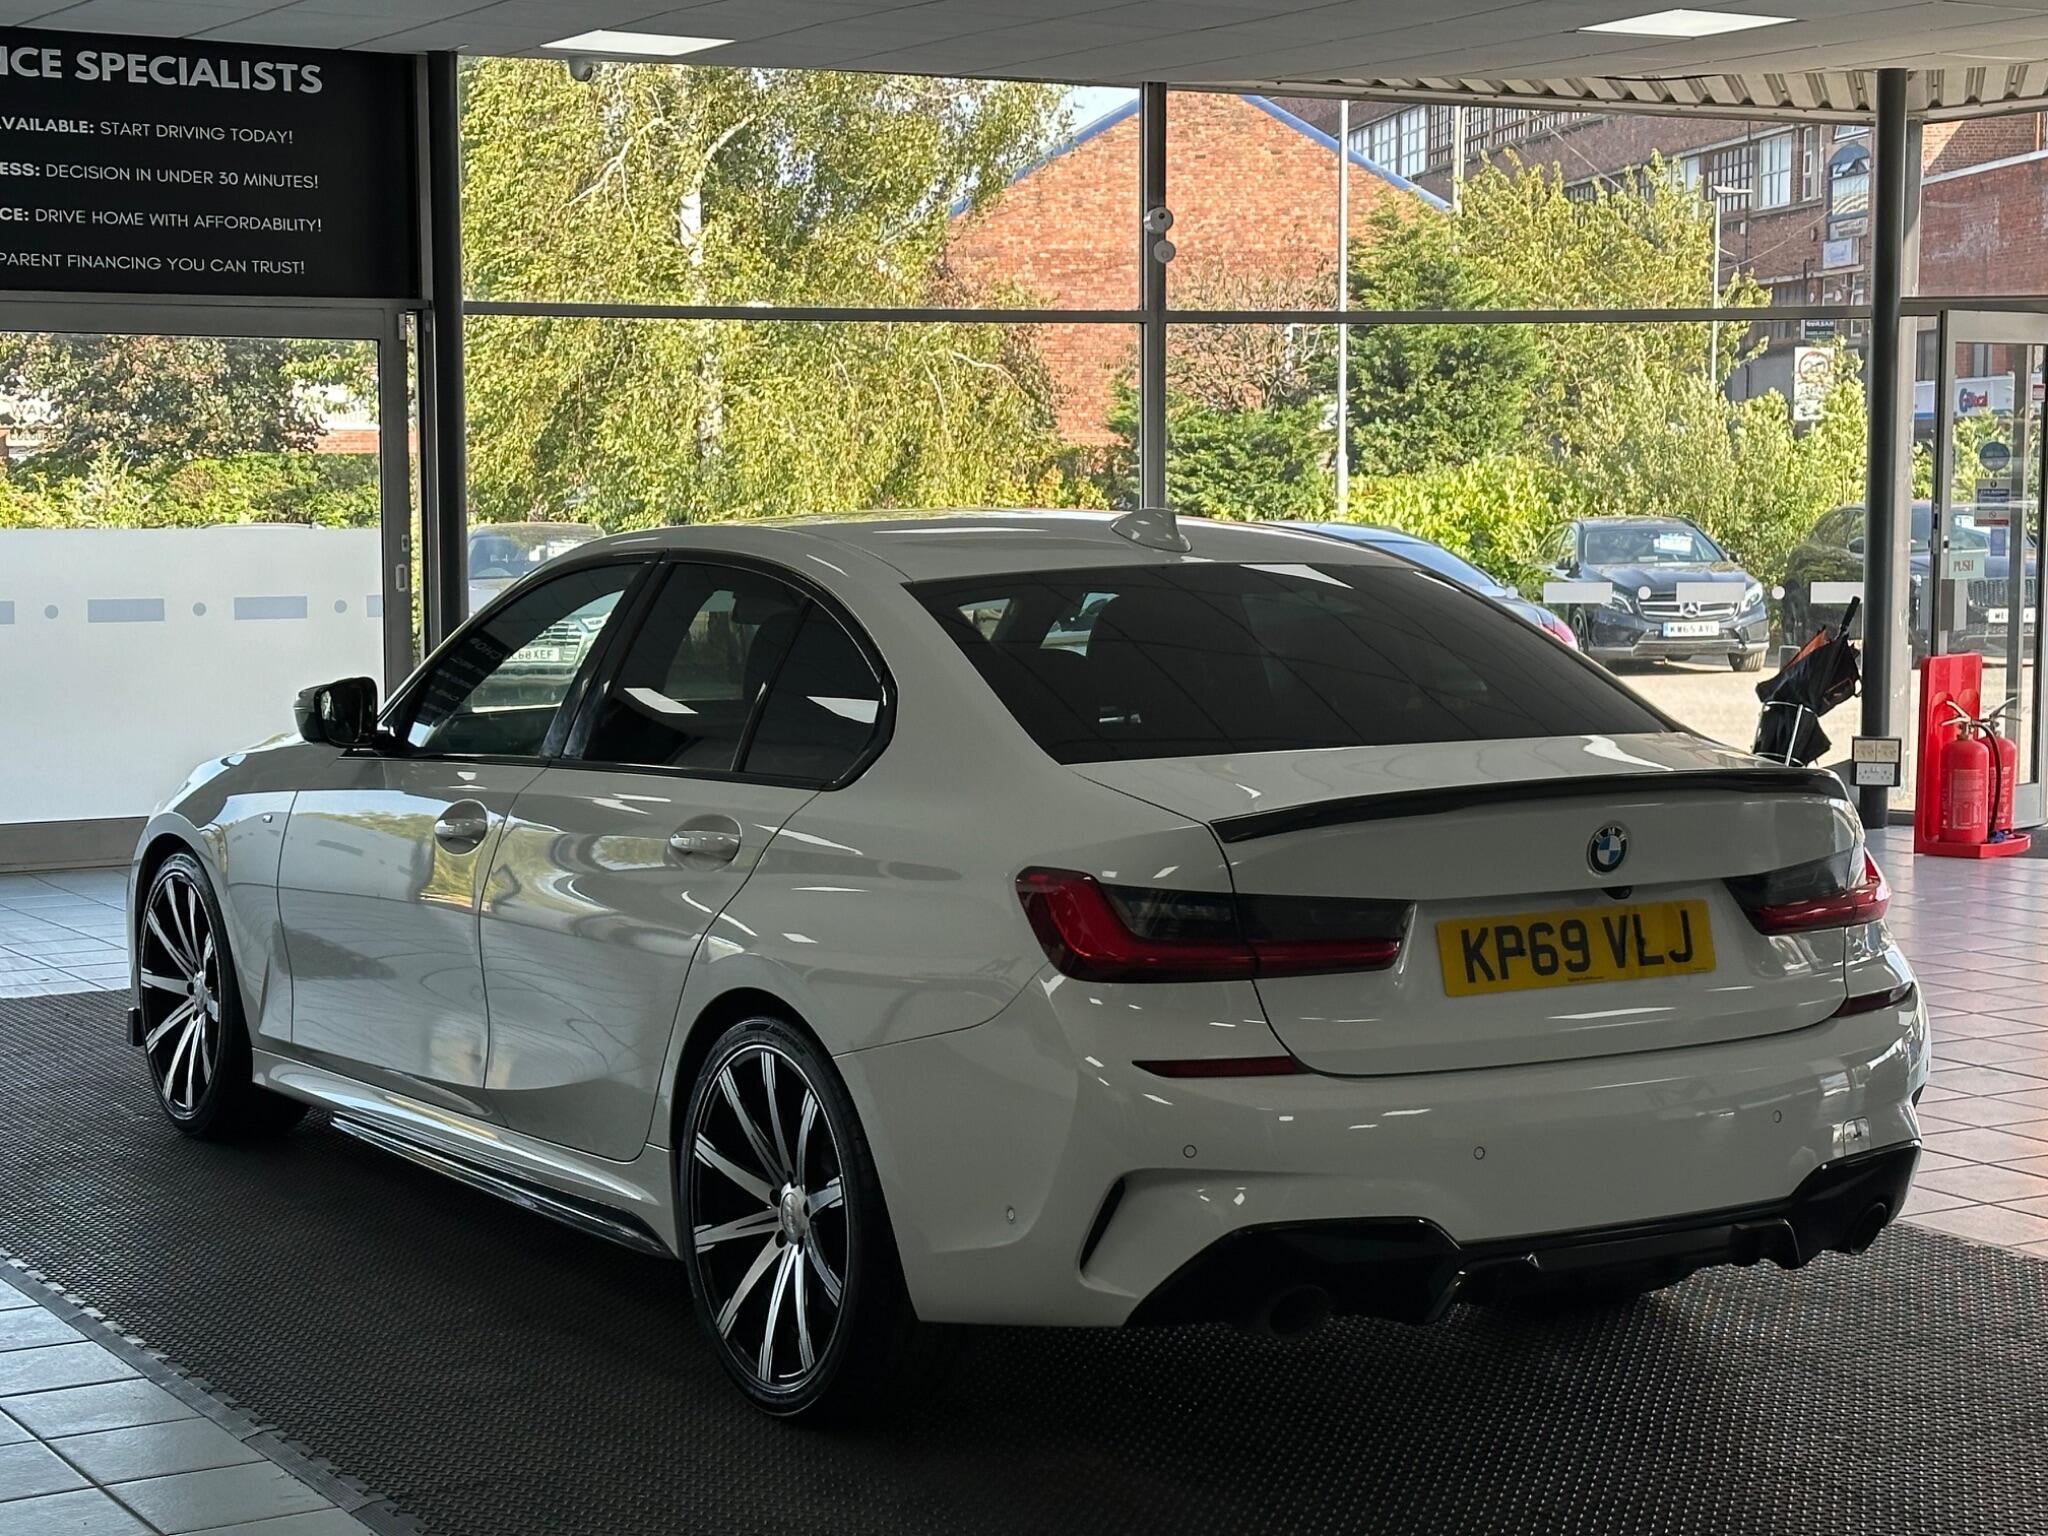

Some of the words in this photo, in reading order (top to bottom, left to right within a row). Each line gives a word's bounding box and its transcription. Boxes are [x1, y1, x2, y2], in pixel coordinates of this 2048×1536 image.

[75, 50, 322, 94] SPECIALISTS
[0, 115, 94, 134] VAILABLE:
[100, 121, 151, 137] START
[156, 124, 226, 141] DRIVING
[229, 127, 293, 145] TODAY!
[45, 163, 131, 181] DECISION
[136, 167, 152, 183] IN
[156, 169, 214, 185] UNDER
[218, 171, 239, 186] 30
[243, 172, 319, 190] MINUTES!
[35, 208, 86, 224] DRIVE
[91, 210, 144, 227] HOME
[148, 213, 189, 228] WITH
[193, 214, 322, 232] AFFORDABILITY!
[67, 254, 162, 271] FINANCING
[166, 257, 206, 272] YOU
[210, 258, 247, 274] CAN
[251, 260, 305, 275] TRUST!
[1953, 559, 1974, 573] PUSH
[1461, 920, 1591, 984] KP69
[1601, 909, 1695, 969] VLJ
